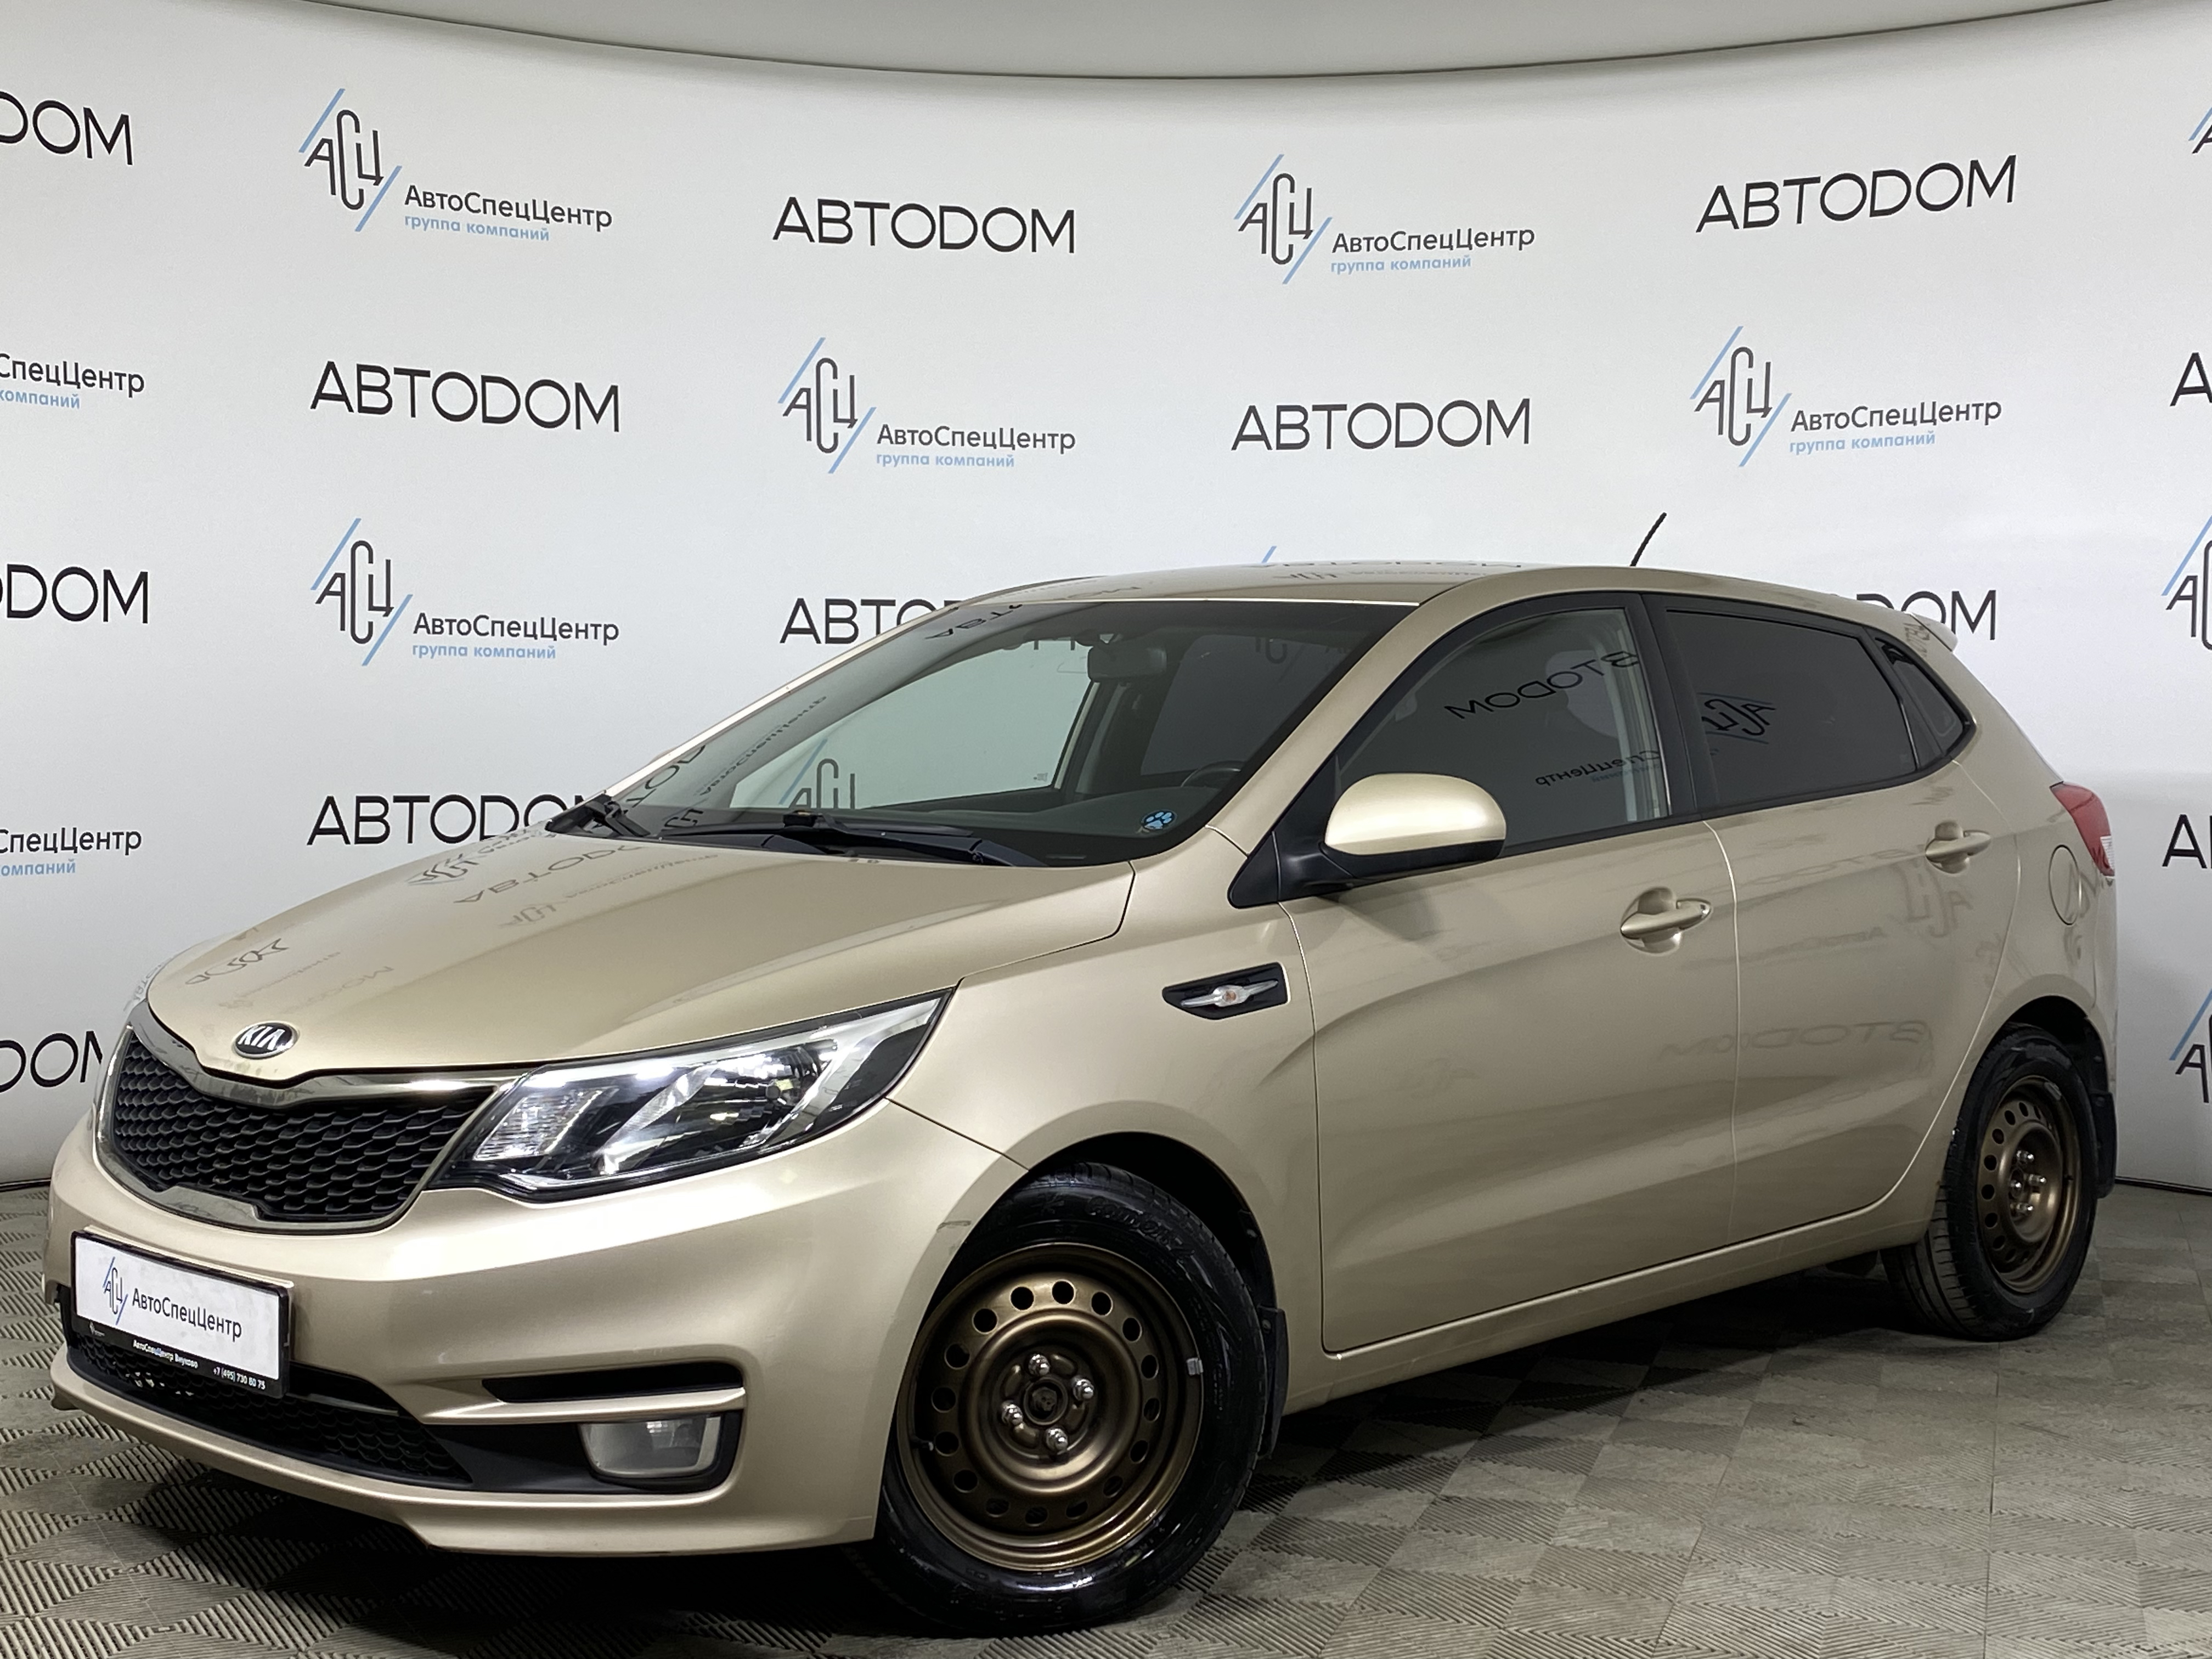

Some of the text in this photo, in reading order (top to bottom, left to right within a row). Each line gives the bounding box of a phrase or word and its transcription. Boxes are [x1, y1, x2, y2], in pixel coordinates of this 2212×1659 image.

[405, 185, 612, 233] АвтоСпецЦентр
[1696, 155, 2016, 233] ABTODOM
[405, 215, 550, 241] группа компаний
[772, 197, 1075, 253] ABTODOM
[1332, 227, 1535, 253] АвтоСпецЦентр
[1331, 255, 1471, 274] группа компаний
[311, 361, 619, 432] ABTODOM
[1231, 398, 1530, 450] ABTODOM
[1791, 401, 2002, 432] АвтоСпецЦентр
[877, 424, 1075, 453] АвтоСпецЦентр
[1789, 431, 1936, 455] группа компаний
[876, 453, 1015, 469] группа компаний
[0, 564, 148, 624] DOM
[413, 613, 619, 645] АвтоСпецЦентр
[412, 643, 556, 660] группа компаний
[307, 794, 585, 845] ABTODO
[238, 1025, 285, 1050] KIA
[132, 1288, 242, 1342] АвтоСпецЦентр
